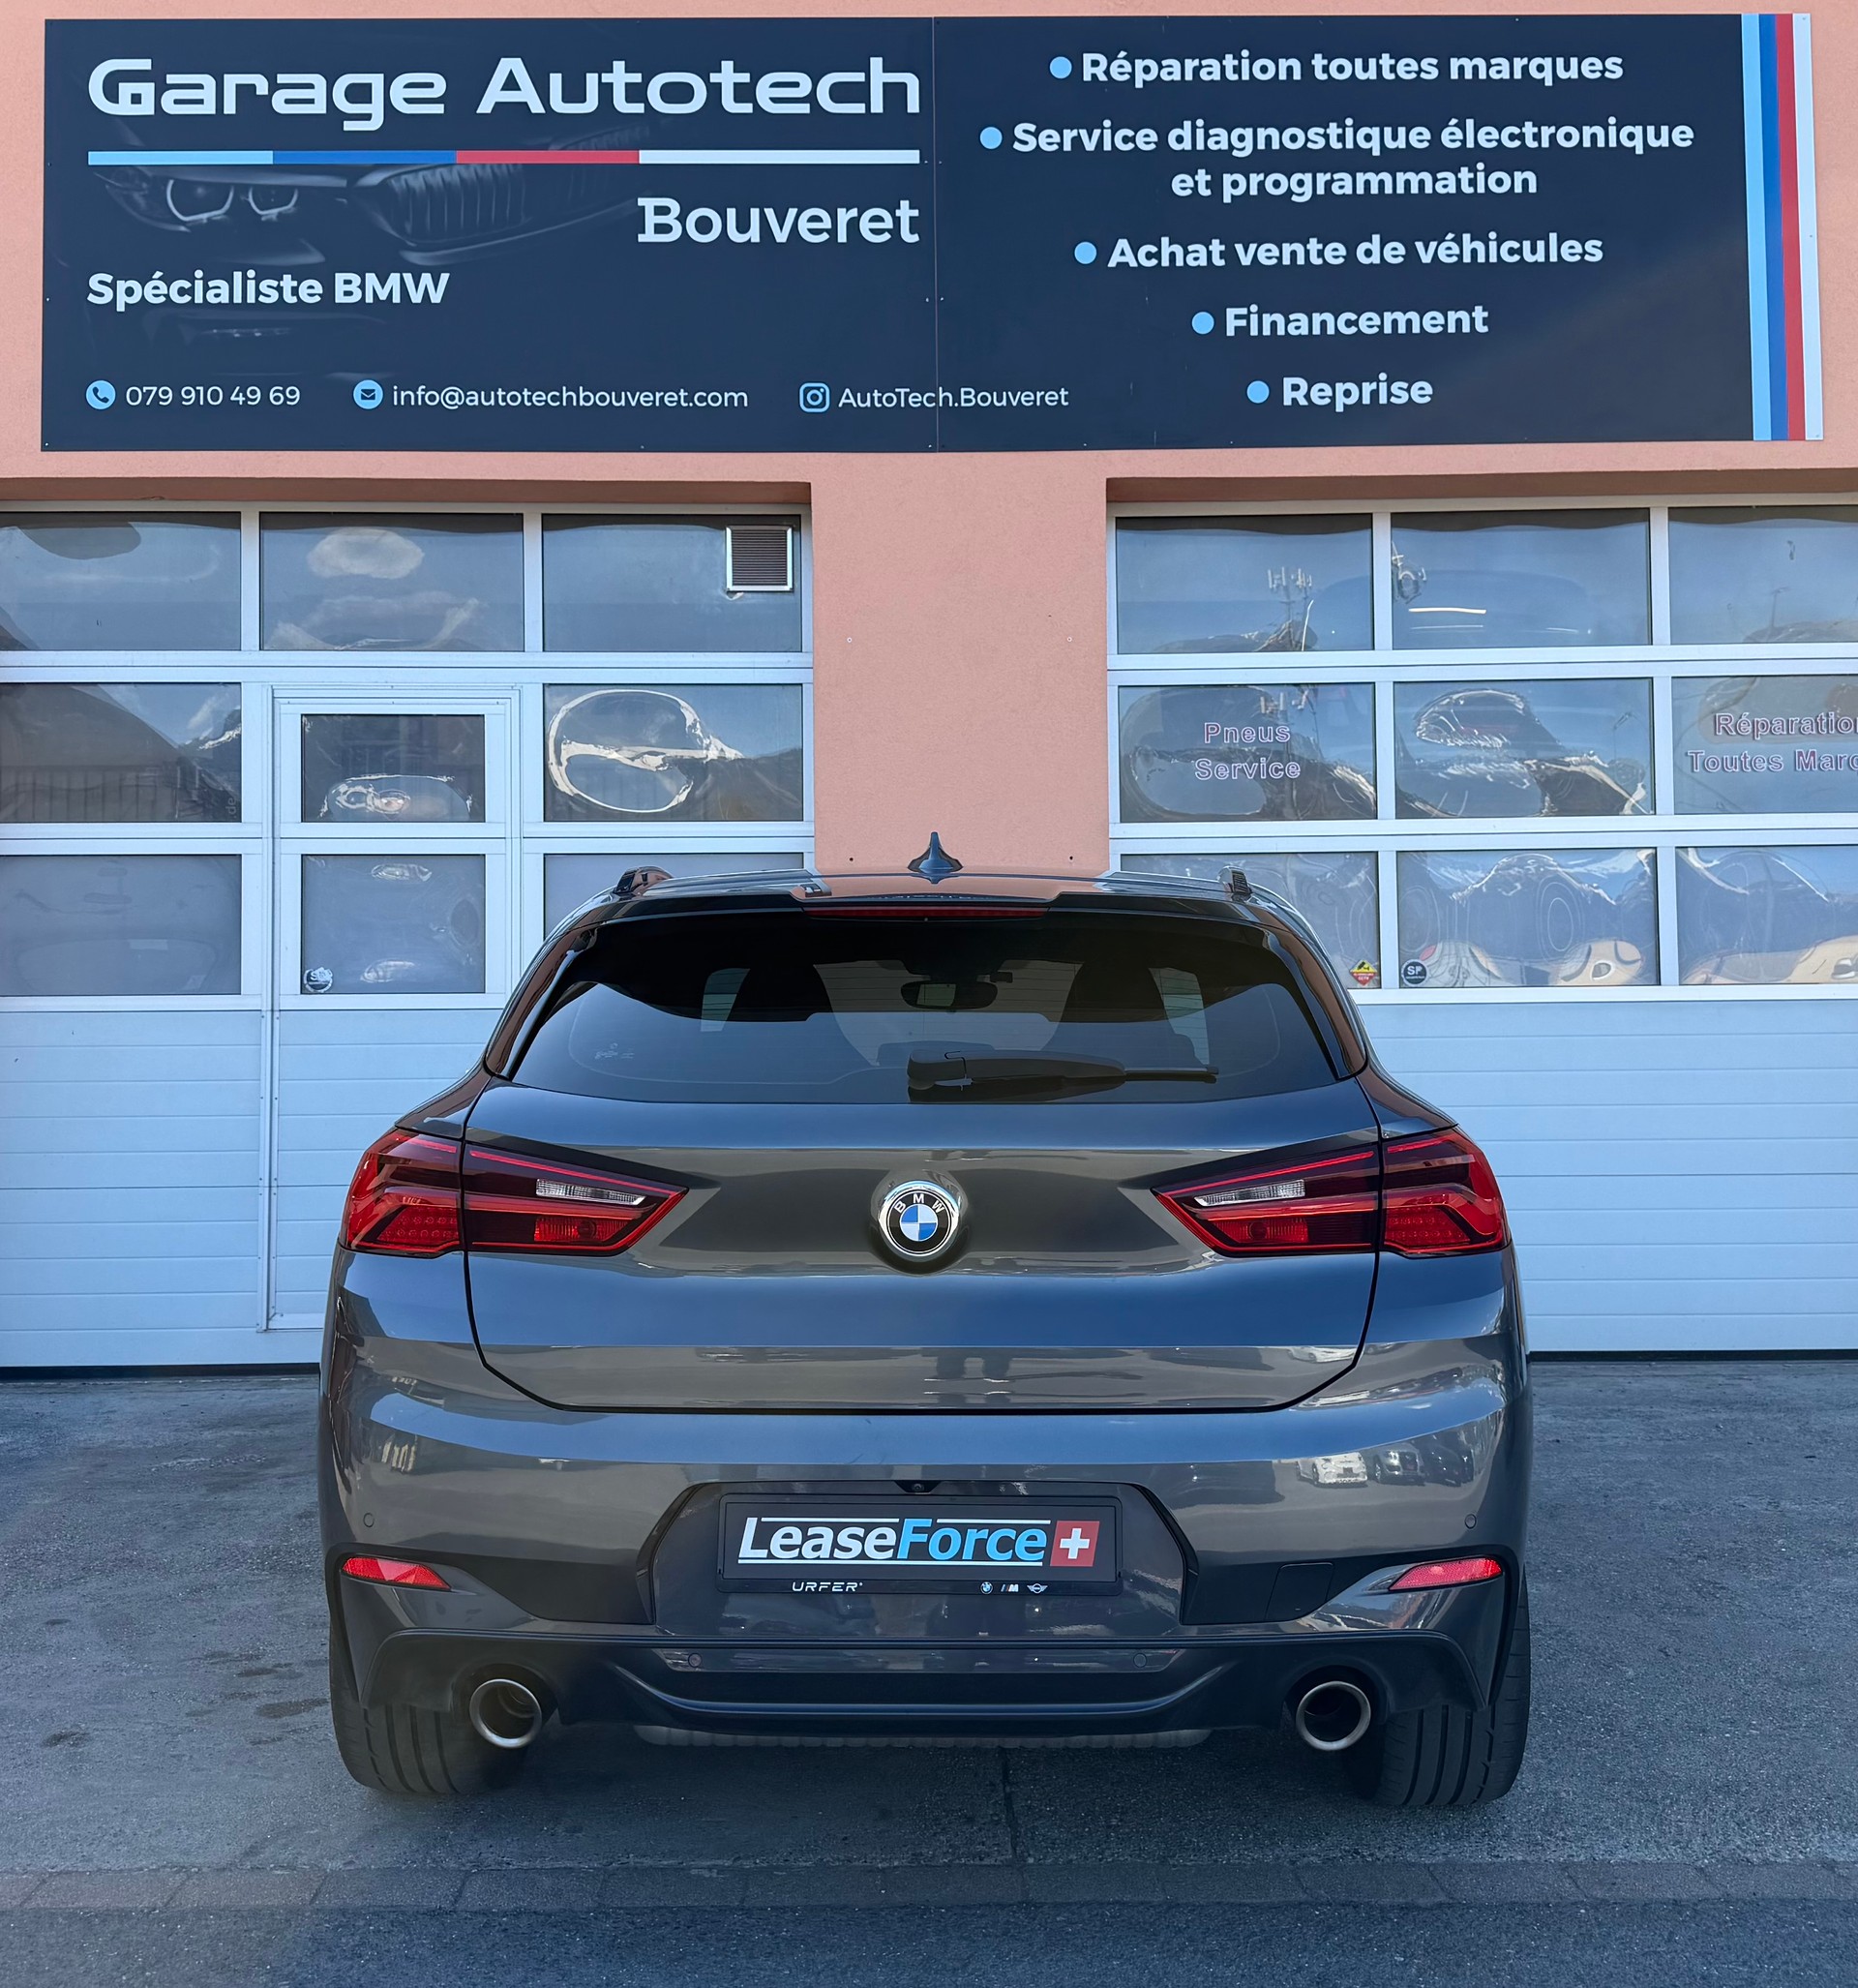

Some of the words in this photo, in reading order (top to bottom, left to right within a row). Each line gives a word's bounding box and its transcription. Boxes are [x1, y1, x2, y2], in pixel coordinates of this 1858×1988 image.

[1082, 48, 1302, 89] Réparation
[1311, 52, 1439, 80] toutes
[1450, 56, 1624, 87] marques
[88, 58, 447, 132] Garage
[475, 56, 920, 114] Autotech
[1012, 119, 1158, 152] Service
[1167, 117, 1431, 157] diagnostique
[1440, 116, 1694, 155] électronique
[1171, 168, 1212, 196] et
[1222, 162, 1537, 203] programmation
[637, 196, 920, 243] Bouveret
[1107, 236, 1226, 268] Achat
[1234, 237, 1347, 266] vente
[1356, 233, 1406, 265] de
[1414, 230, 1603, 264] véhicules
[86, 269, 323, 313] Spécialiste
[334, 272, 451, 304] BMW
[1226, 304, 1489, 337] Financement
[126, 386, 173, 406] 079
[181, 385, 224, 406] 910
[229, 385, 261, 406] 49
[269, 385, 300, 406] 69
[393, 384, 748, 410] info@autotechbouveret.com
[838, 386, 1069, 407] AutoTech.Bouveret
[1282, 372, 1433, 412] Reprise
[1204, 721, 1291, 744] Pneus
[1715, 712, 1858, 740] Réparatio
[1194, 757, 1302, 781] Service
[1688, 750, 1783, 772] Toutes
[893, 1192, 945, 1214] BMW
[737, 1517, 1048, 1561] LeaseForce
